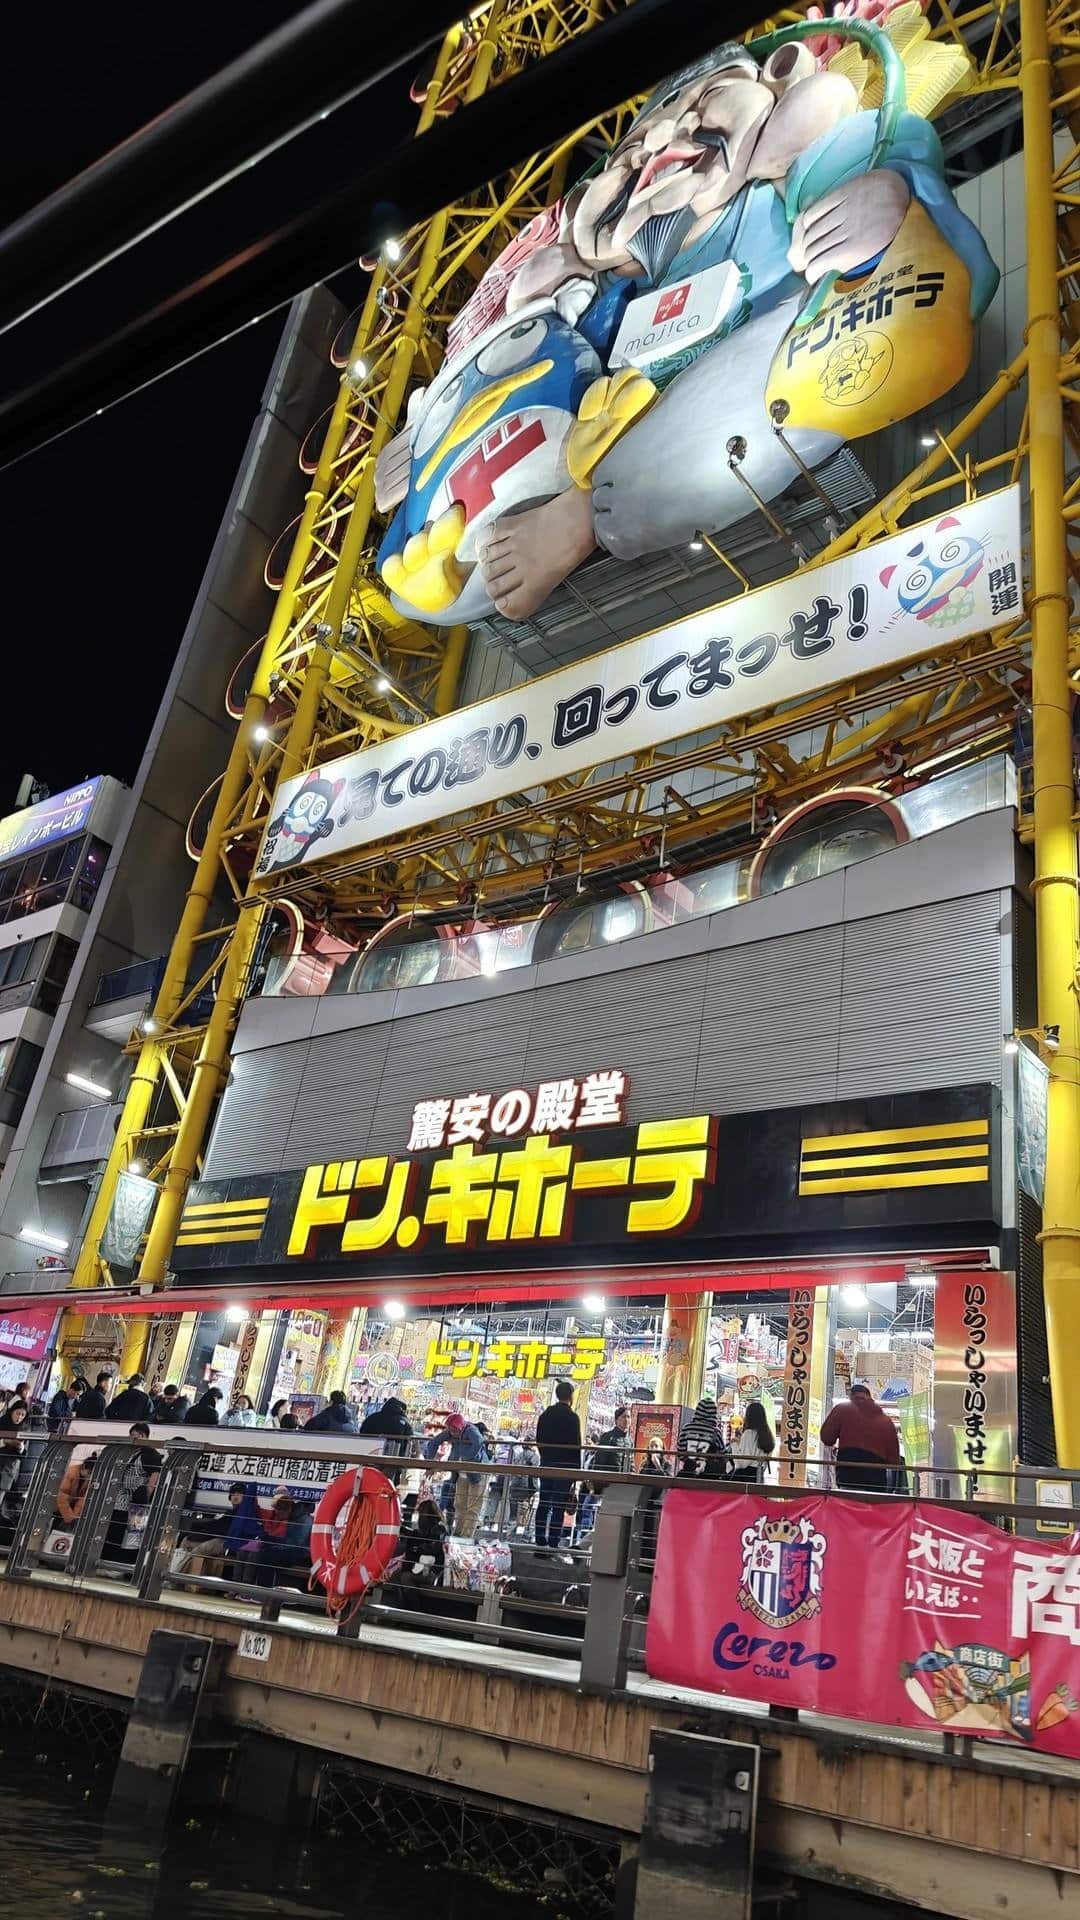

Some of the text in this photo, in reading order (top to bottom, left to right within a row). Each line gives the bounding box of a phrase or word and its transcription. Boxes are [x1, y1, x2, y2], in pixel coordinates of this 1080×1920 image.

[987, 561, 1018, 616] 開運
[64, 785, 93, 806] NIPPO
[406, 1070, 625, 1152] 驚安の殿堂
[907, 1530, 985, 1578] 大阪と
[713, 1622, 837, 1671] Cerezo
[959, 1646, 1004, 1668] 商店街
[752, 1664, 790, 1680] OSAKA
